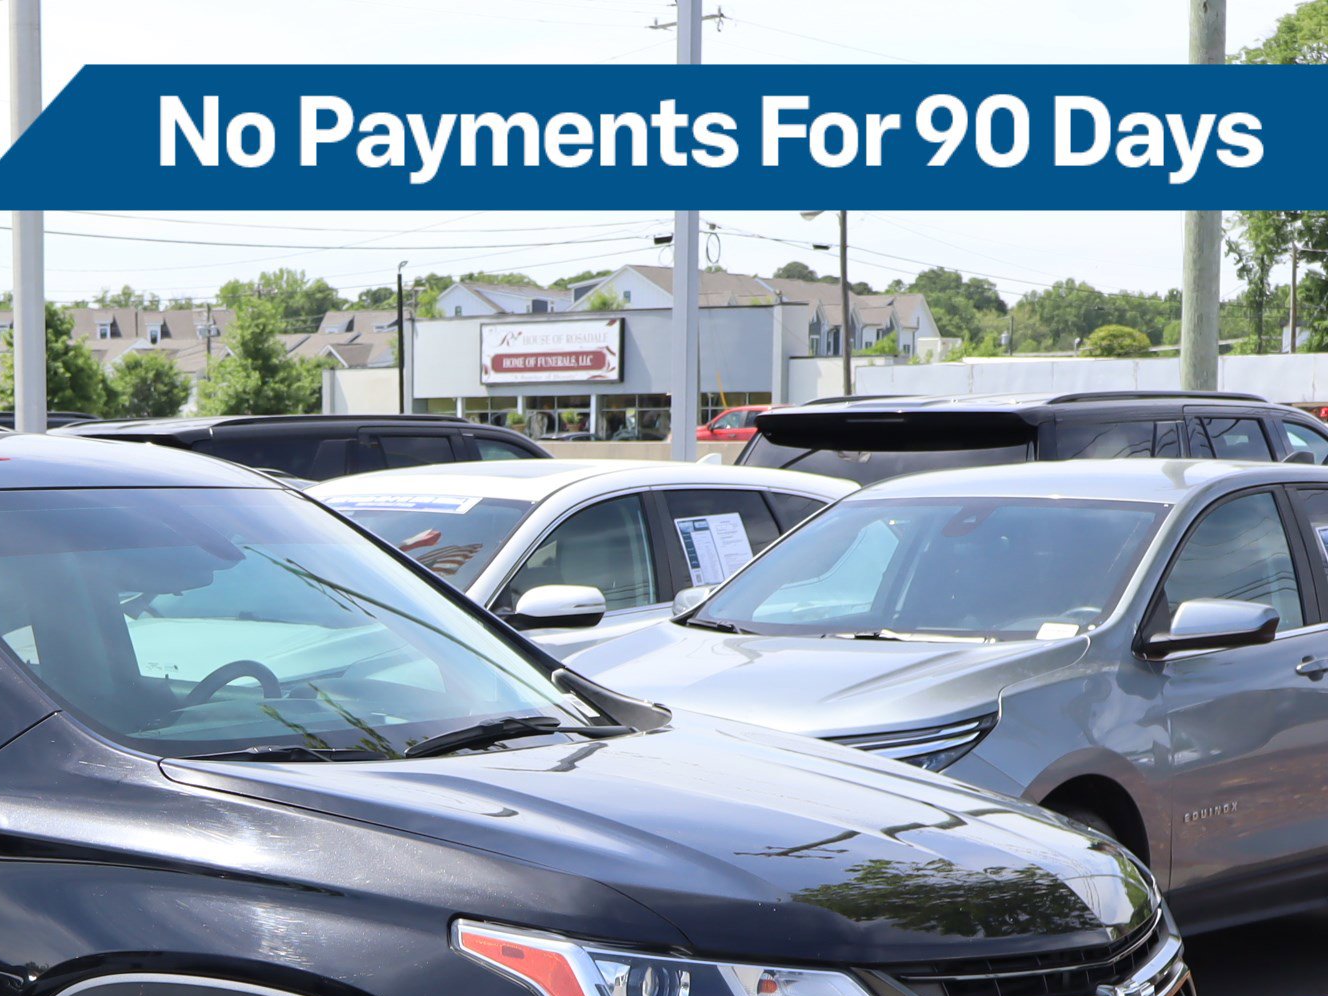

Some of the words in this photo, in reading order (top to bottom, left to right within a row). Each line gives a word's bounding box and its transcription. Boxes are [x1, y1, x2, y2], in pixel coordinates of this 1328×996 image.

[502, 357, 524, 369] HOME
[525, 357, 537, 368] OF
[1184, 801, 1239, 823] EQUINOX
